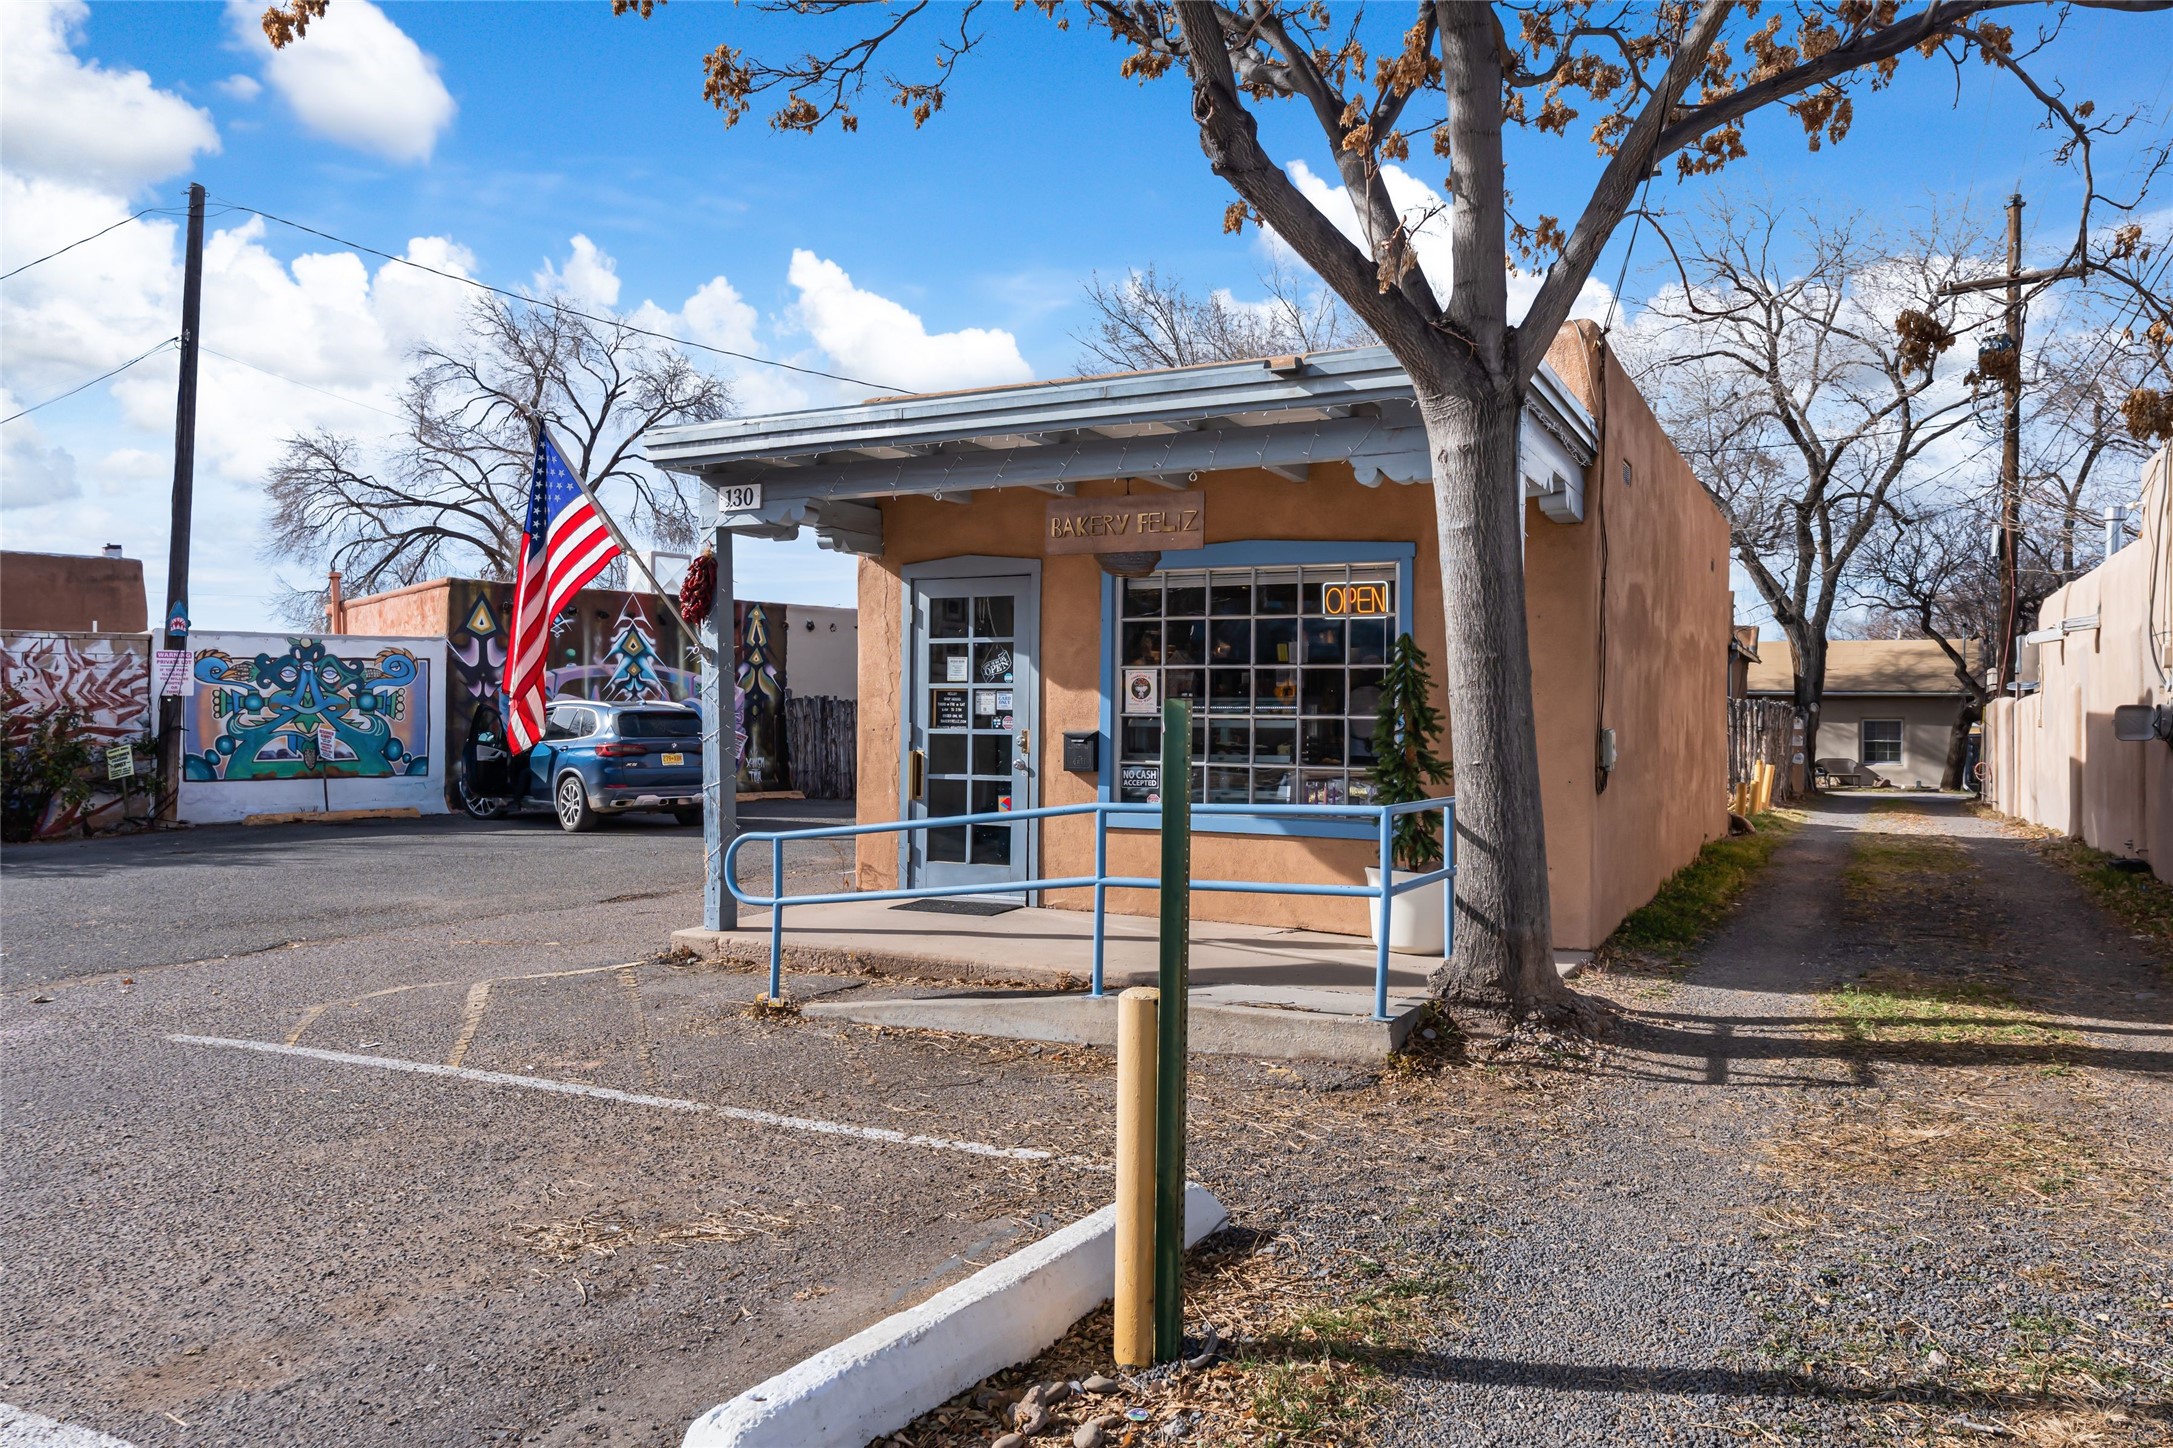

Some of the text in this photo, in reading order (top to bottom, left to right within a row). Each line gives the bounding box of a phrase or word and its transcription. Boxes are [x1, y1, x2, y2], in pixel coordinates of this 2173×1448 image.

[725, 487, 754, 507] 130
[1050, 509, 1200, 539] BAKERY FELIZ
[1325, 586, 1386, 614] OPEN
[984, 660, 1010, 676] OPEN
[1123, 770, 1157, 779] NO CASH
